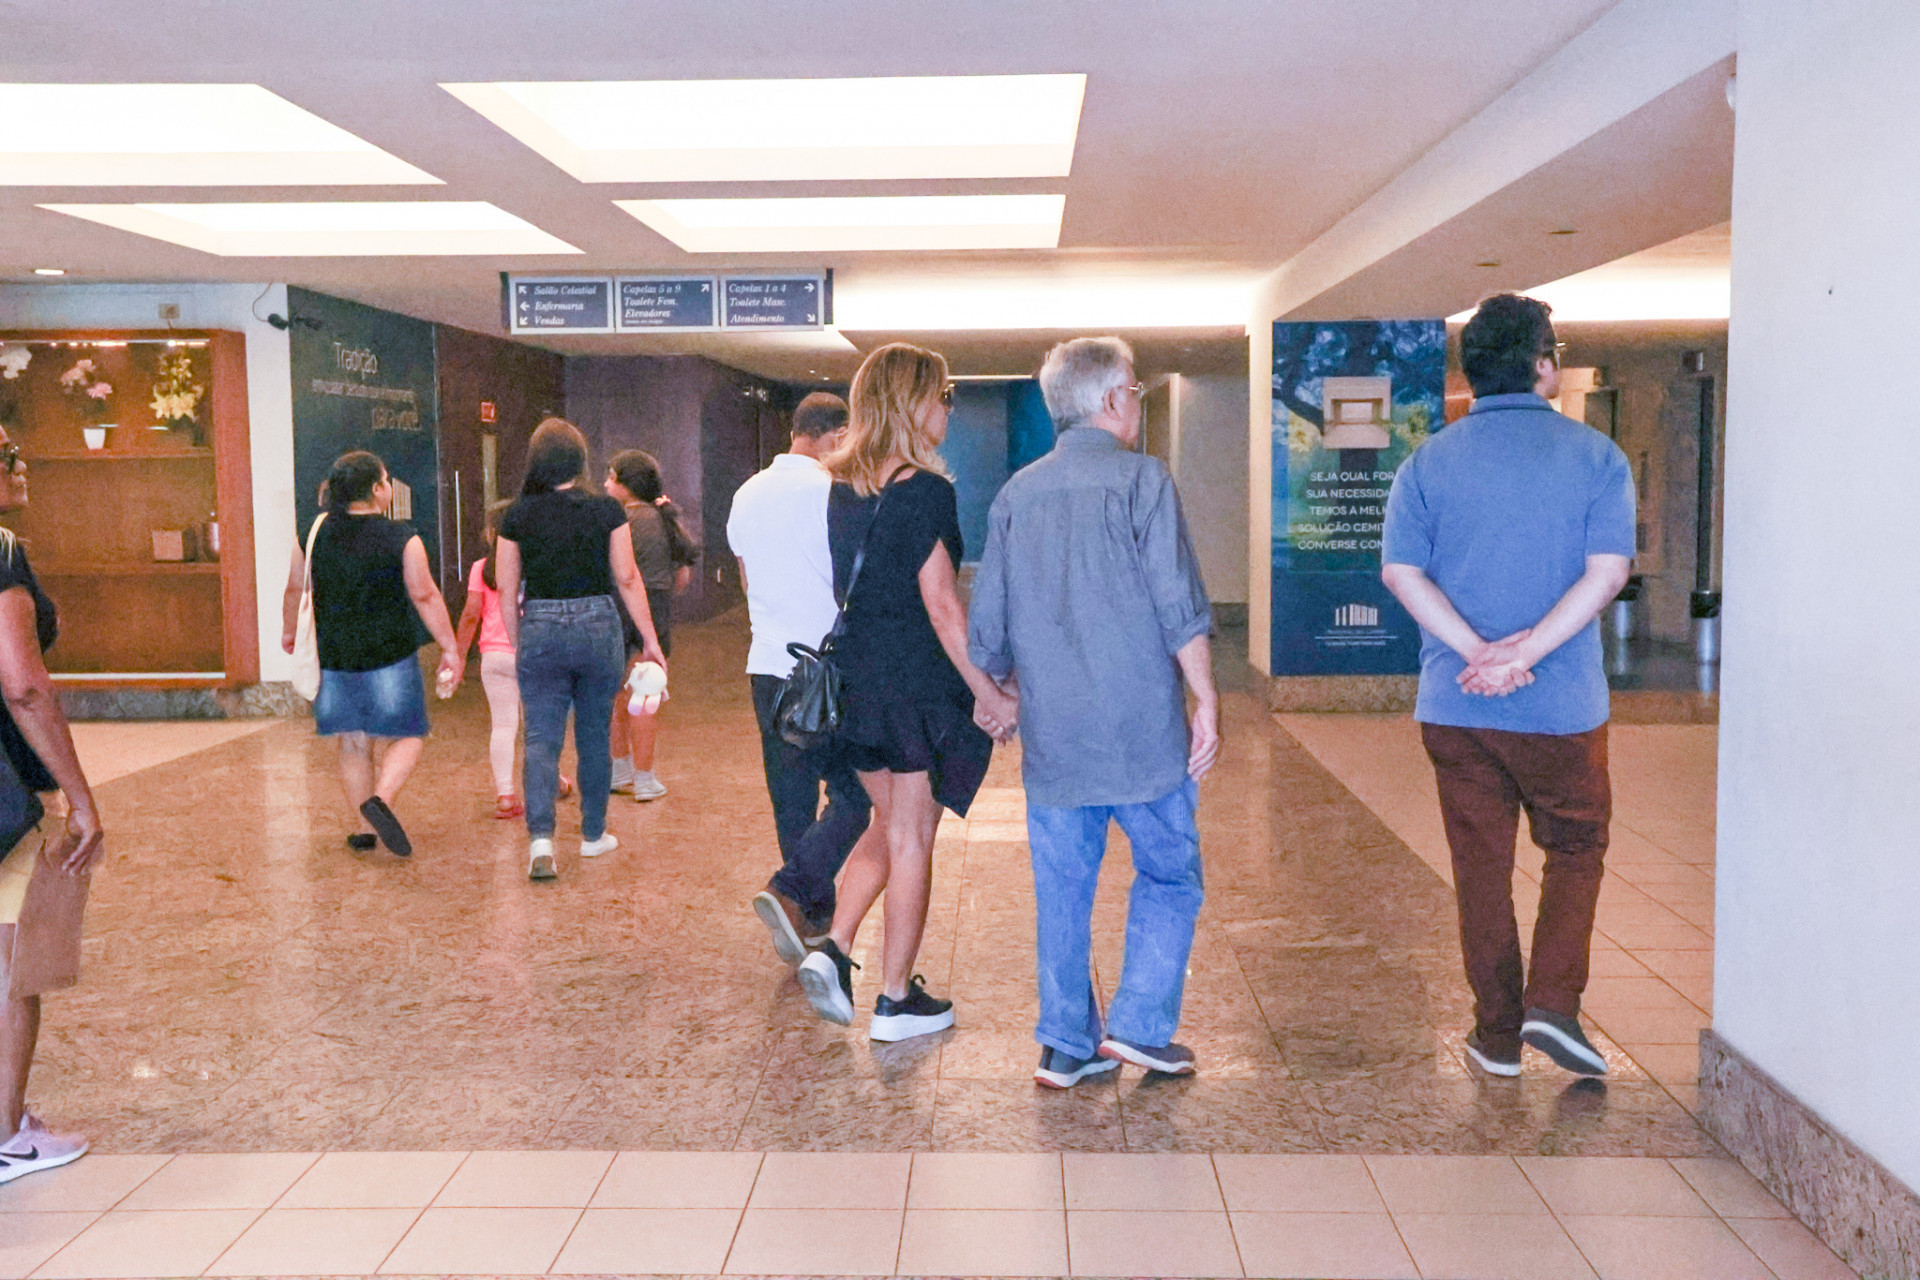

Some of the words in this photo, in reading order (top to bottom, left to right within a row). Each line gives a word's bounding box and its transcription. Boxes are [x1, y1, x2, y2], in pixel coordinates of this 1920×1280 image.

[561, 285, 597, 295] Celestial
[623, 284, 656, 296] Capelas
[674, 285, 682, 293] 9
[729, 283, 762, 294] Capelas
[780, 284, 787, 293] 4
[535, 301, 584, 312] Enfermaria
[624, 297, 655, 306] Toalete
[657, 297, 678, 306] Fem.
[729, 298, 760, 307] Toalete
[625, 309, 671, 318] Elevadores
[730, 313, 785, 323] Atendimento
[535, 316, 565, 325] Vendas
[1310, 471, 1338, 481] SEJA
[1340, 471, 1370, 482] QUAL
[1373, 471, 1395, 481] FOR
[1306, 488, 1328, 499] SUA
[1310, 506, 1347, 515] TEMOS
[1349, 506, 1357, 515] A
[1298, 521, 1351, 535] SOLUÇÃO
[1298, 540, 1357, 550] CONVERSE
